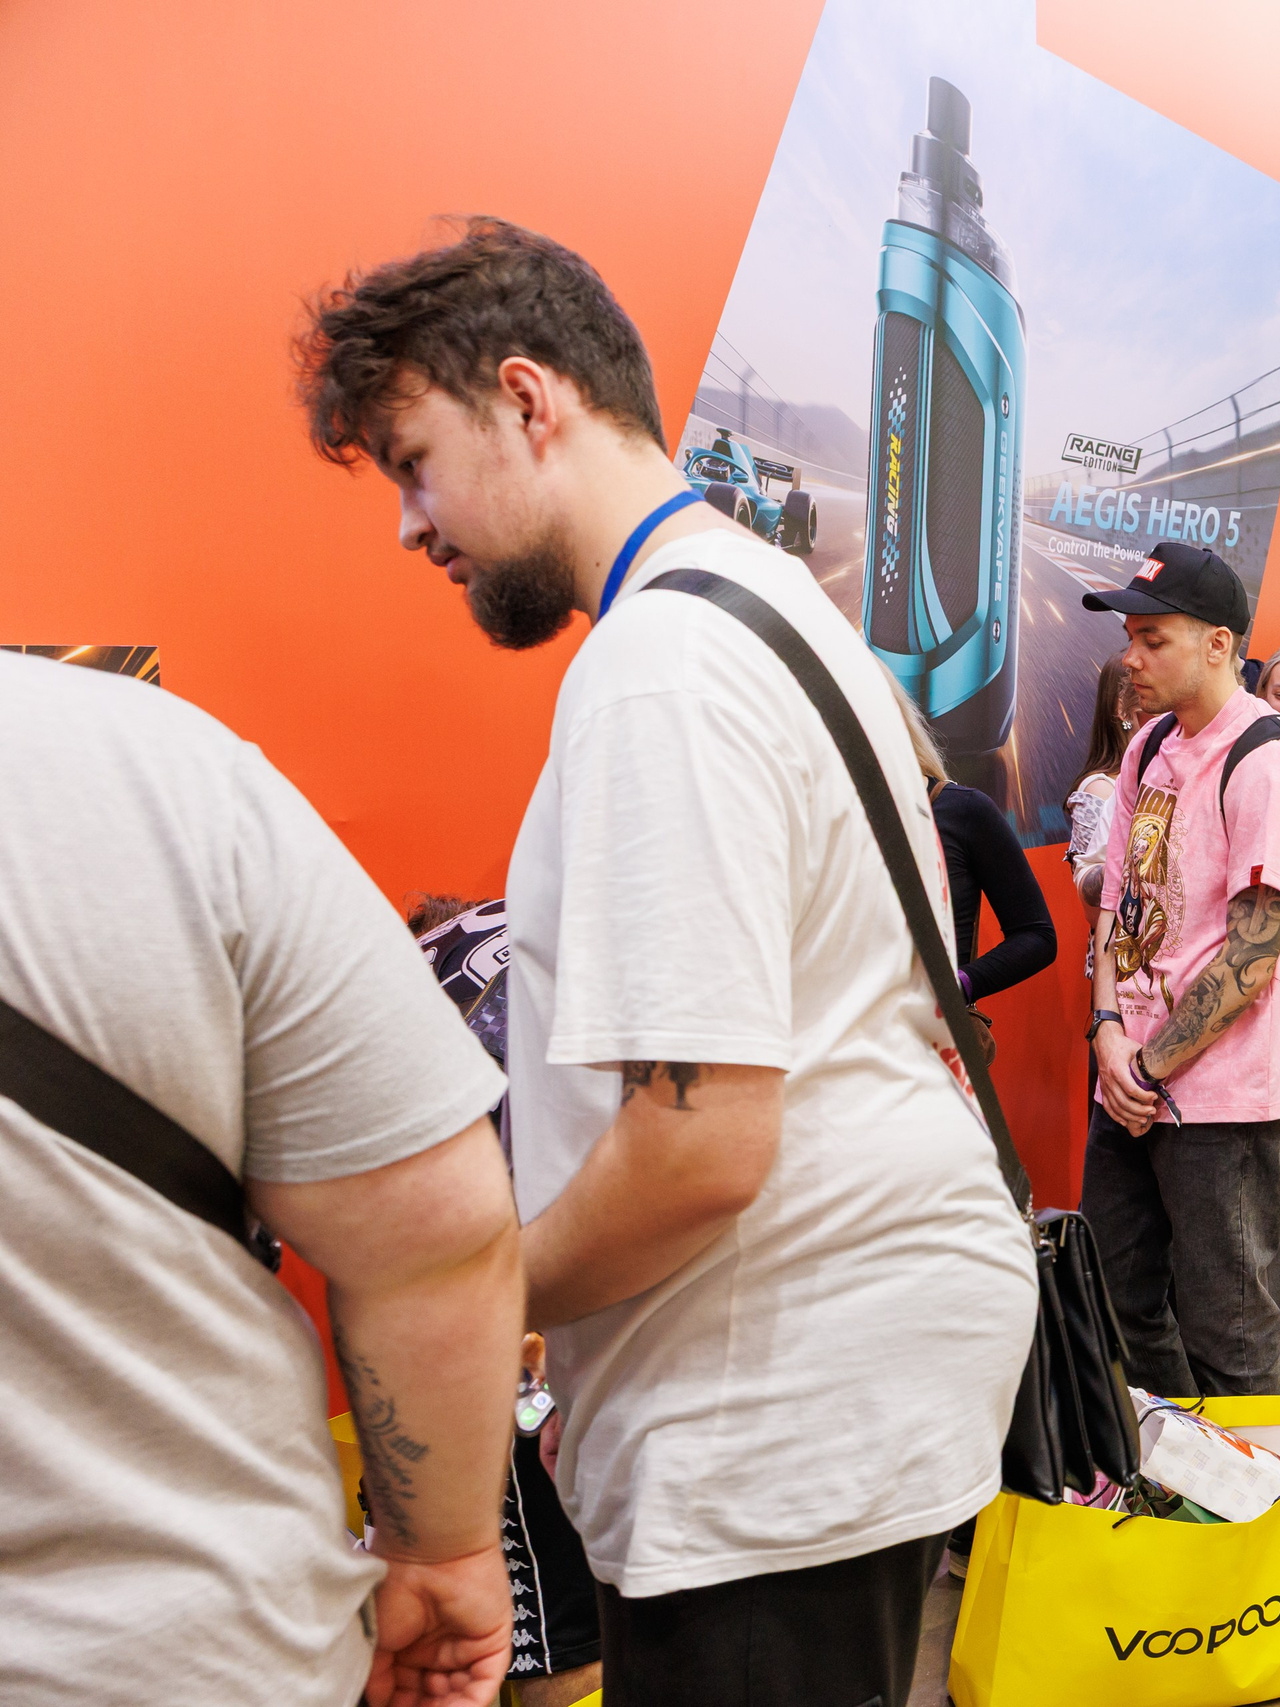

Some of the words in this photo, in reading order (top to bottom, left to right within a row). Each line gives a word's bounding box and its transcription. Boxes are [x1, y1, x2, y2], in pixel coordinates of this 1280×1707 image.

[1069, 437, 1135, 463] RACING
[1083, 456, 1118, 473] EDITION
[887, 433, 902, 537] RACING
[995, 430, 1008, 602] GEEKVAPE
[1049, 481, 1142, 533] AEGIS
[1146, 497, 1221, 545] HERO
[1225, 511, 1241, 548] 5
[1049, 536, 1090, 557] Control
[1093, 541, 1110, 559] the
